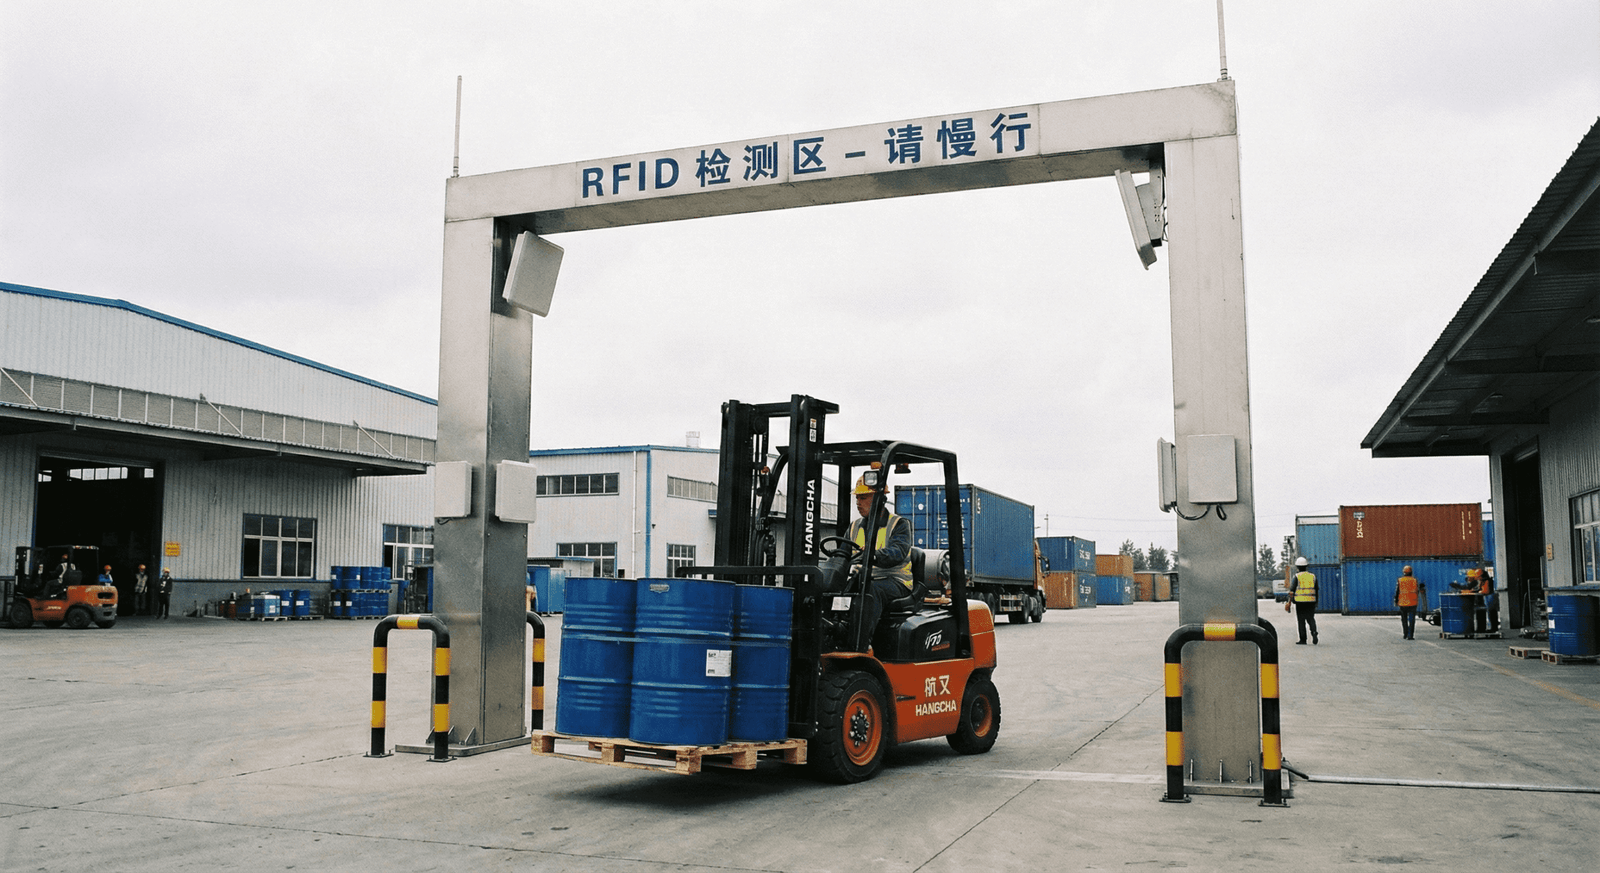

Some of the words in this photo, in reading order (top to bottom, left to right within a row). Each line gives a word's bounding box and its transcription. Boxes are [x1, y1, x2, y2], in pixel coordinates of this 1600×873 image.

[582, 157, 678, 198] RFID
[695, 137, 826, 187] 检测区
[884, 112, 1032, 163] 请慢行
[804, 479, 816, 555] HANGCHA
[915, 700, 957, 716] HANGCHA
